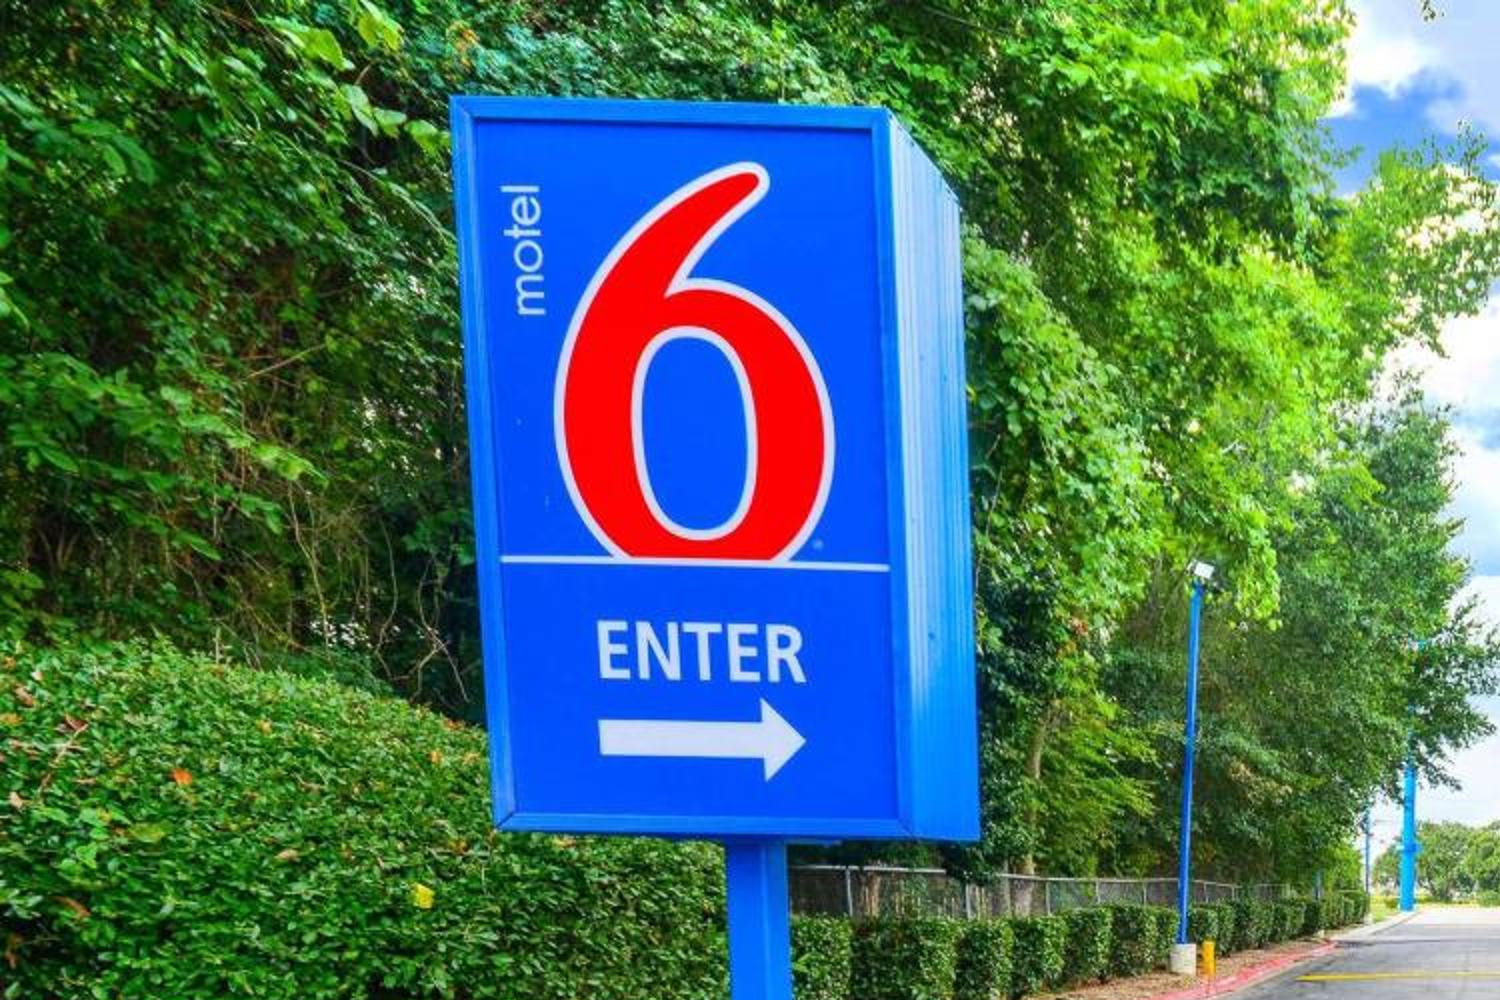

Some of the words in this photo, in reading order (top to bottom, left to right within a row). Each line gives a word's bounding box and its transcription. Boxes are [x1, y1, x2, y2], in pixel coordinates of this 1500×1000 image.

[501, 185, 546, 315] motel
[554, 161, 835, 563] 6
[597, 619, 806, 683] ENTER
